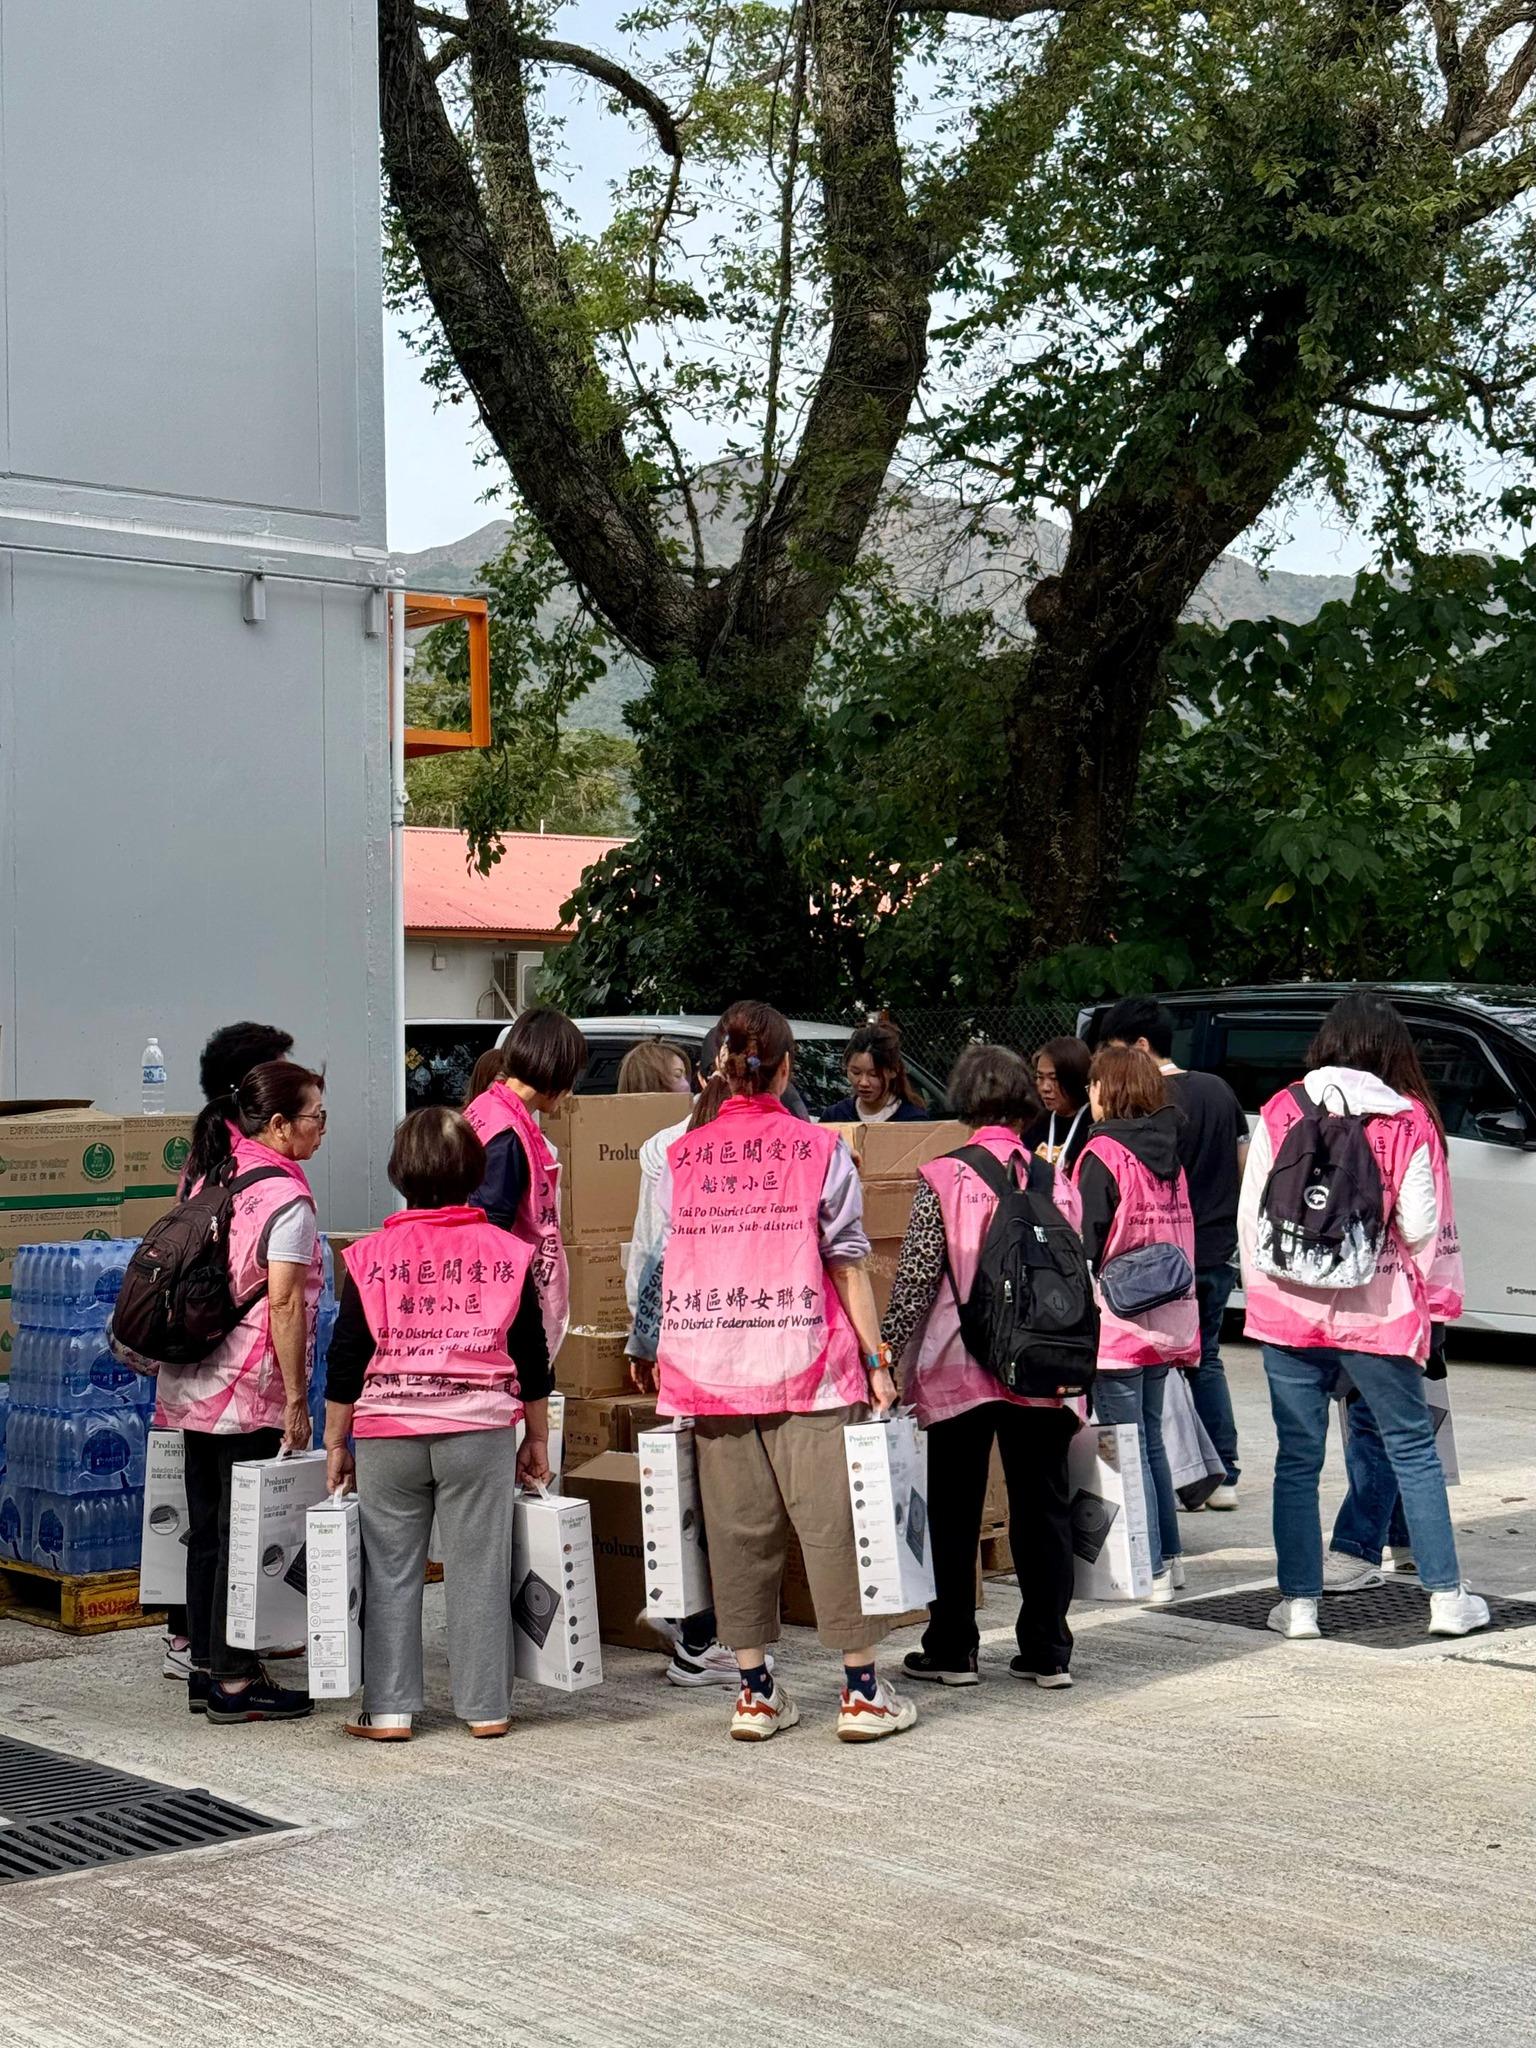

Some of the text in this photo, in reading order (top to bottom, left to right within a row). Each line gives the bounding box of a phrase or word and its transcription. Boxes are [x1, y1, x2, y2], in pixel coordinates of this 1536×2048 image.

[701, 1171, 779, 1194] 船灣小區
[679, 1203, 798, 1218] Tai Po District Care Teams
[671, 1221, 803, 1236] Shuen Wan Sub-district
[397, 1293, 481, 1316] 船灣小區
[665, 1285, 819, 1314] 大埔區婦女聯會
[668, 1319, 679, 1331] Po
[681, 1317, 714, 1331] District
[716, 1315, 775, 1330] Federation
[778, 1315, 789, 1329] of
[391, 1328, 403, 1339] Po
[406, 1328, 443, 1339] District
[446, 1328, 469, 1338] Care
[376, 1341, 499, 1357] huen Wan Sub-distri
